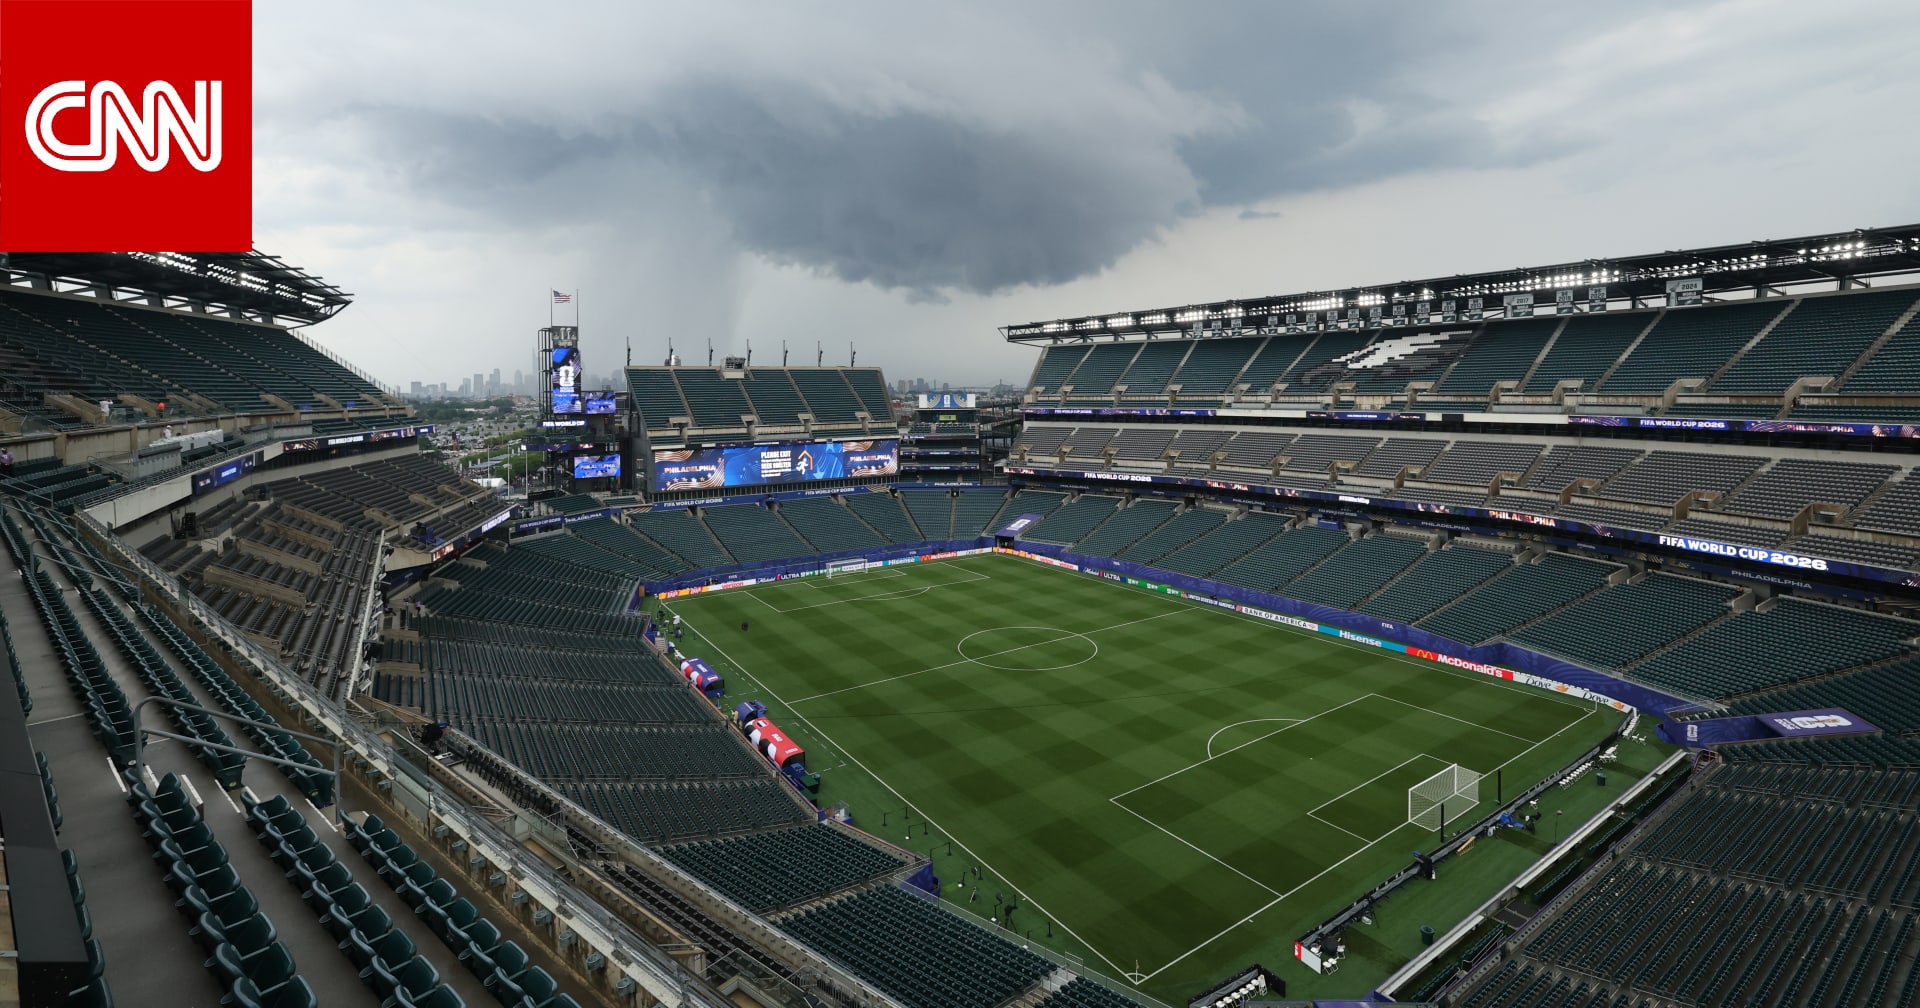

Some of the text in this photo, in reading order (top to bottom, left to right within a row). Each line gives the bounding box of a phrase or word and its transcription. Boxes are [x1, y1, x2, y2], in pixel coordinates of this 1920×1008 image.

[1786, 424, 1855, 433] PHILALPHIA
[850, 454, 892, 462] PHILADELPHIA
[664, 465, 716, 473] PHILADELPHIA
[1207, 481, 1249, 491] PHILALPHIA
[1489, 510, 1556, 527] PHILADELPHIA
[1421, 521, 1471, 531] PHILADELPHIA
[1659, 535, 1828, 571] FIFA WORLD CUP 2026
[888, 558, 915, 566] Hisense
[1103, 572, 1121, 581] ULTRA
[1731, 570, 1812, 589] PHILADELPHIA
[1218, 601, 1235, 610] AMERICA
[1244, 607, 1263, 616] BANK
[1275, 615, 1307, 627] AMERICA
[1381, 622, 1394, 630] FIFA
[1339, 630, 1382, 647] Hisense
[1437, 653, 1503, 678] McDonald's
[1525, 677, 1551, 689] Dove
[1582, 691, 1608, 704] Dove
